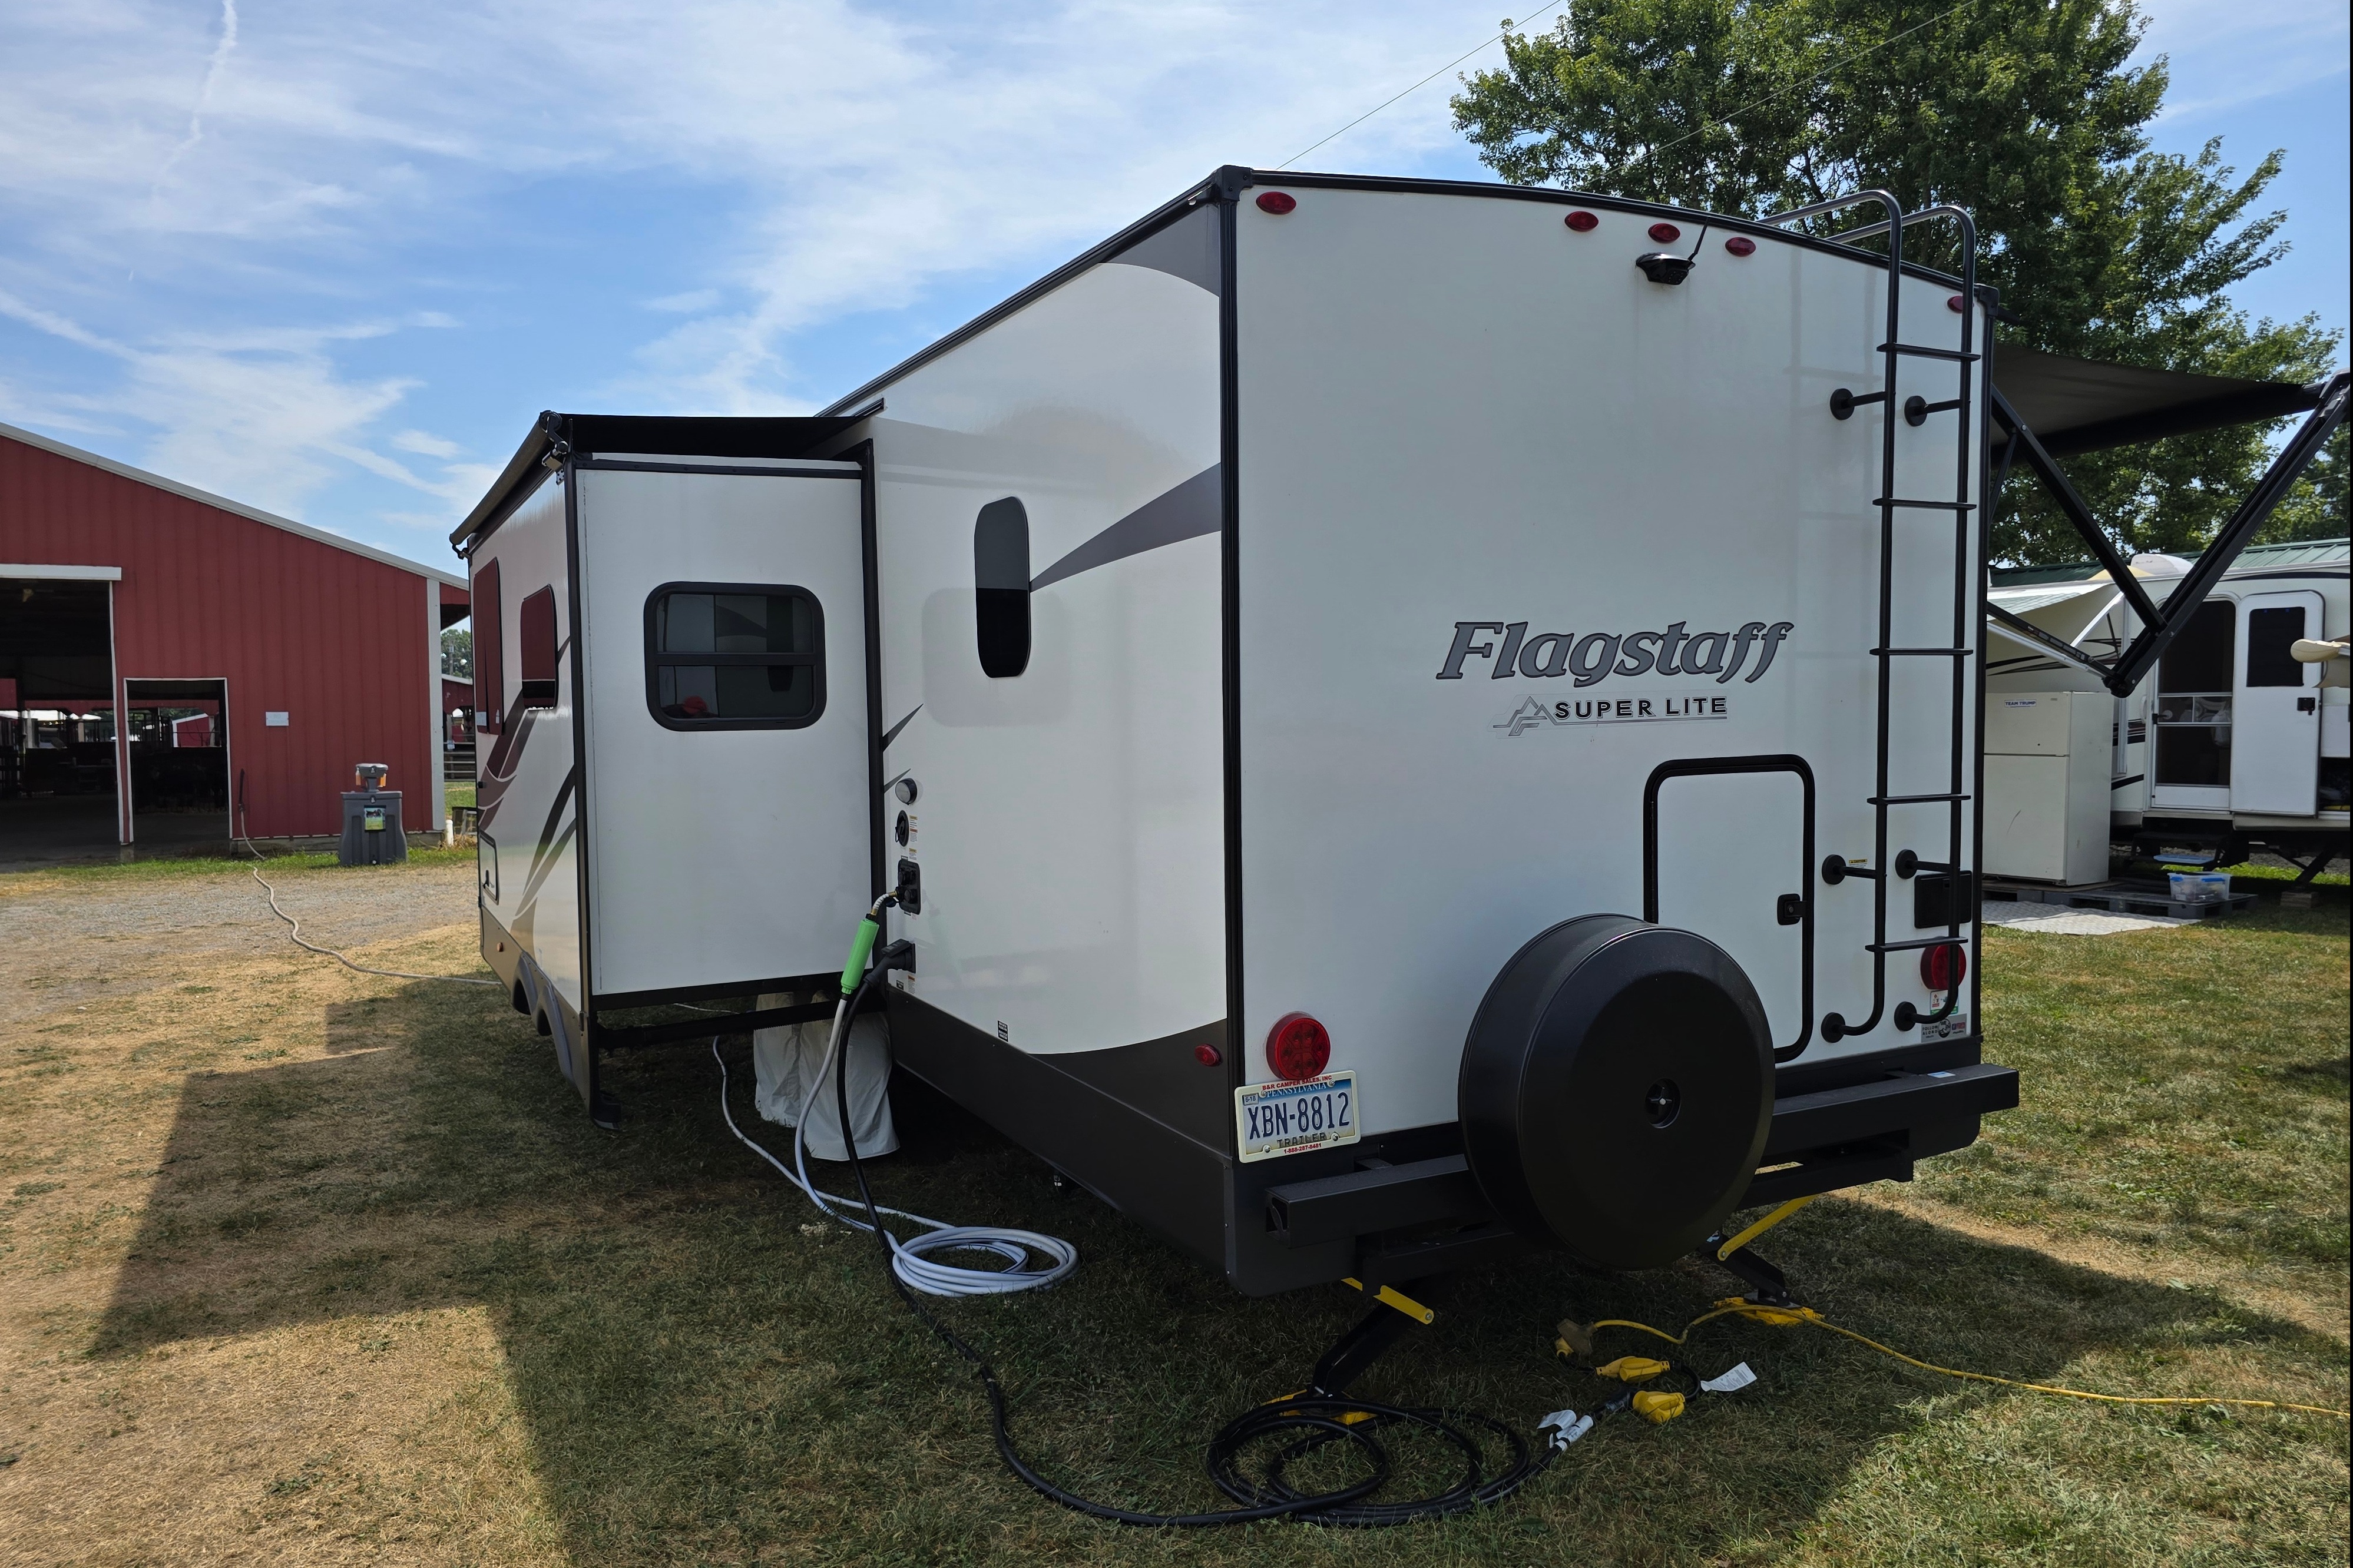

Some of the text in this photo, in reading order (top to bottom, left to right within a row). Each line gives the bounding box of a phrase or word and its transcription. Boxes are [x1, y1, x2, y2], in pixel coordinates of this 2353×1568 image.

[1435, 620, 1795, 688] Flagstaff
[1554, 695, 1728, 720] SUPER LITE
[1267, 1082, 1327, 1098] PENNSYLVANIA
[1276, 1079, 1301, 1088] CAMPER
[1247, 1092, 1350, 1140] XBN-8812
[1276, 1132, 1327, 1148] TRAILER
